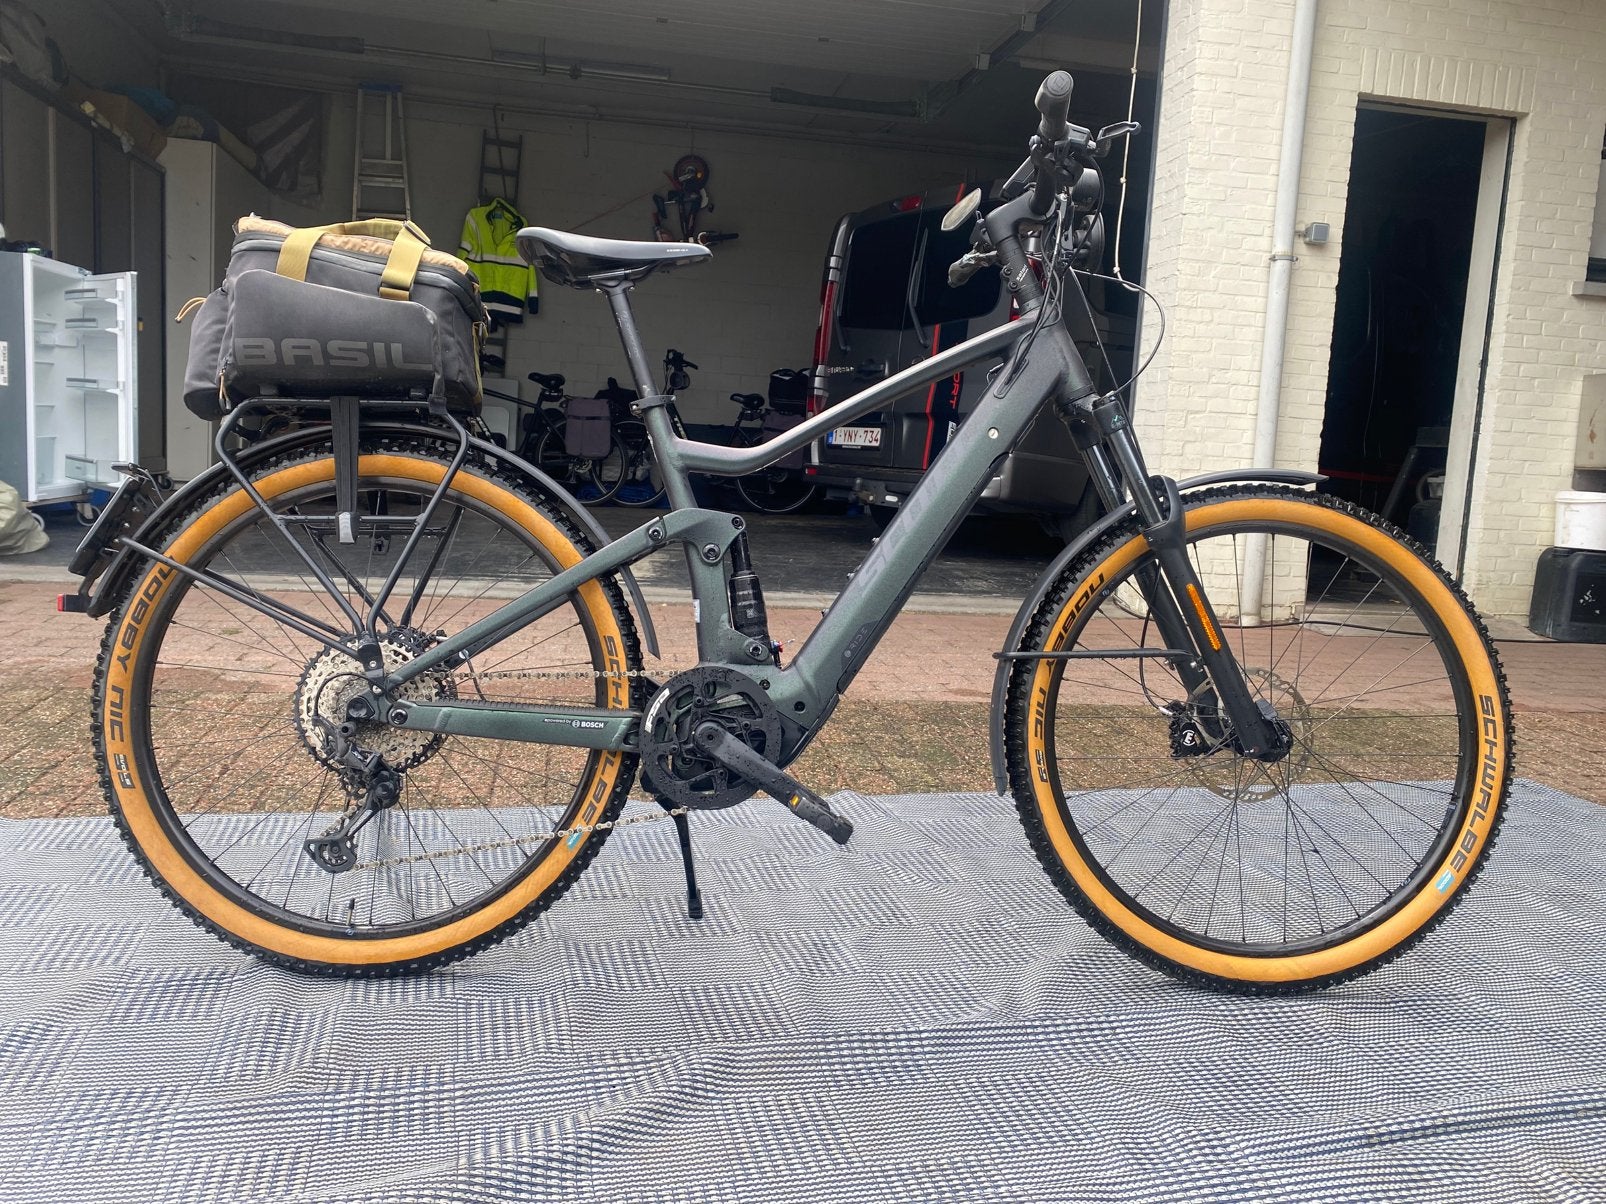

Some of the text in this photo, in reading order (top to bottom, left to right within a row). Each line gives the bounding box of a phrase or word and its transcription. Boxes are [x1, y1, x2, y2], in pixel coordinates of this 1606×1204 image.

[234, 337, 433, 371] BASIL
[115, 555, 176, 675] NOBBY
[110, 684, 124, 742] NIC
[581, 721, 604, 729] BOSCH
[581, 635, 623, 825] SCHLBE
[1034, 686, 1047, 740] NIC
[1450, 694, 1498, 873] SCHWALBE
